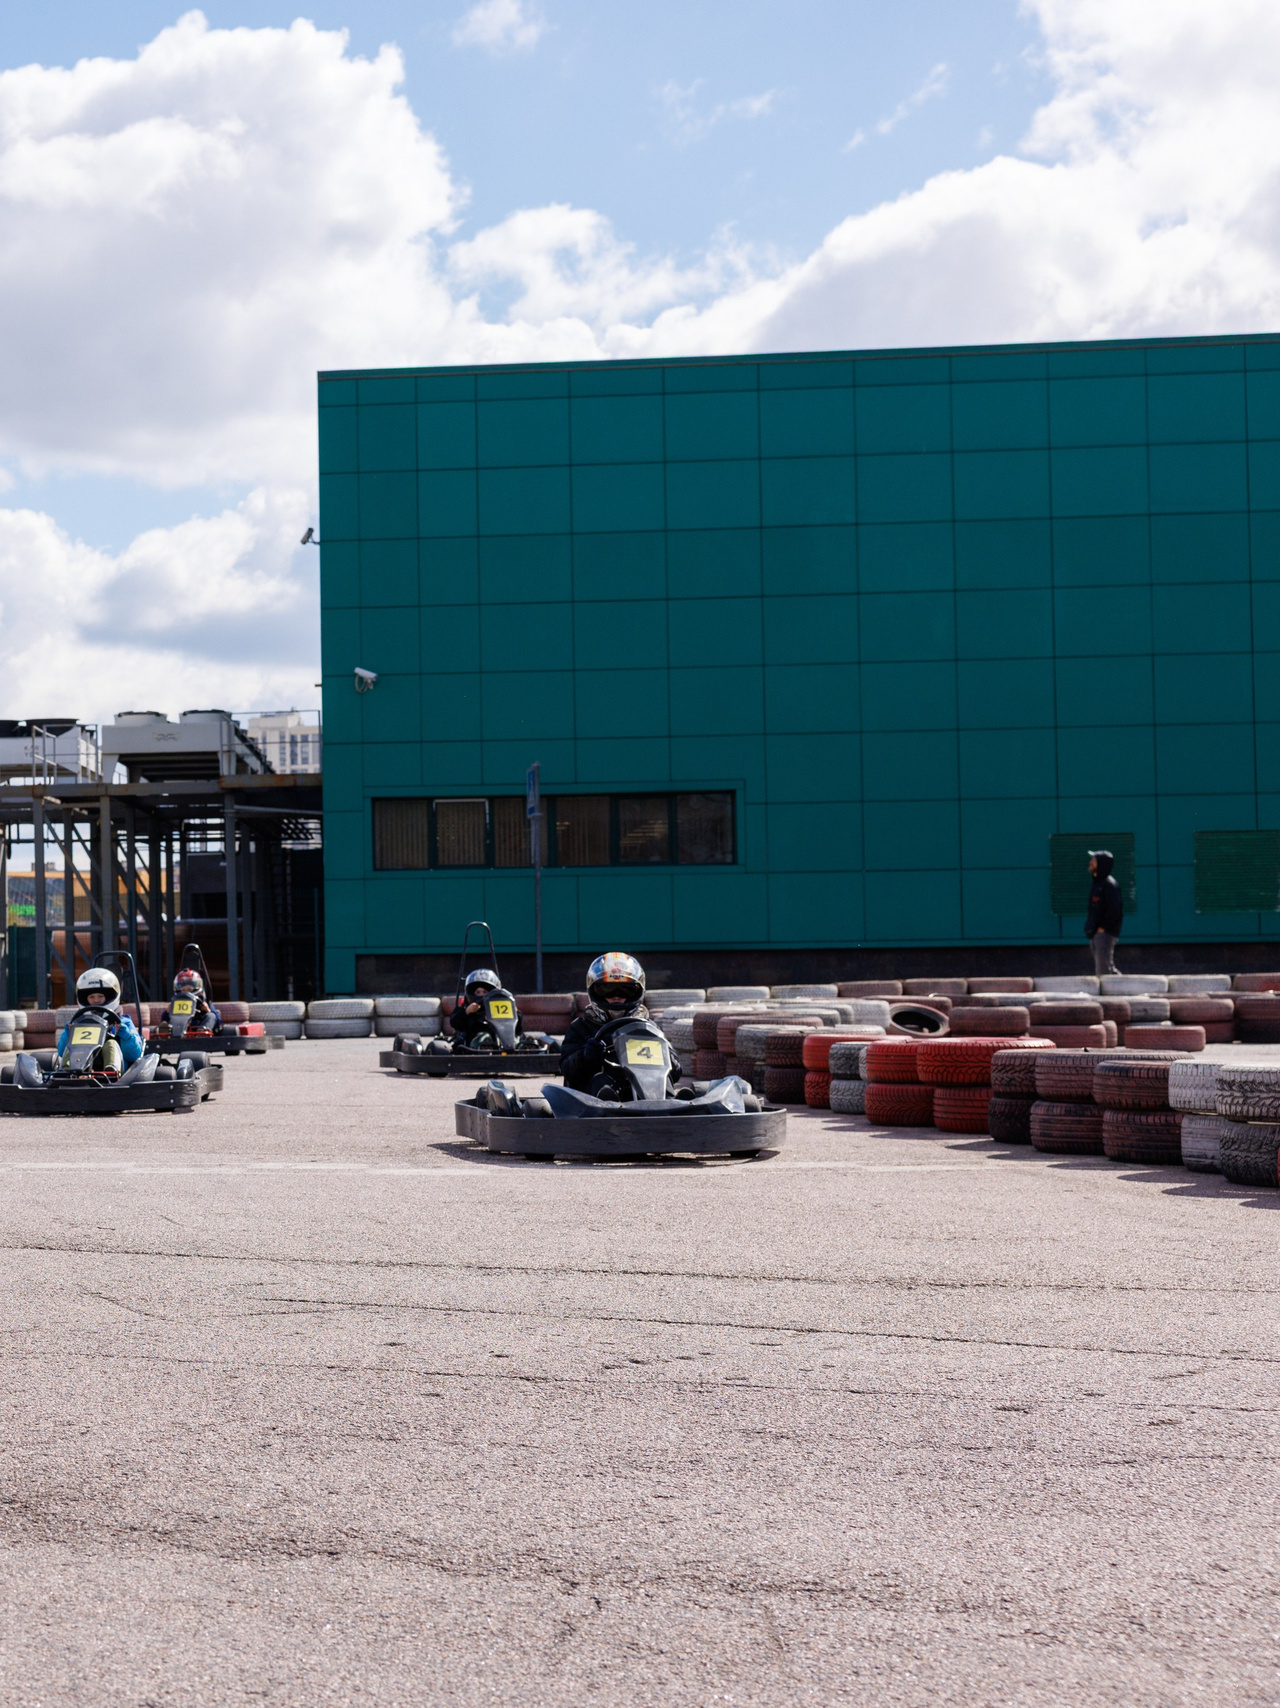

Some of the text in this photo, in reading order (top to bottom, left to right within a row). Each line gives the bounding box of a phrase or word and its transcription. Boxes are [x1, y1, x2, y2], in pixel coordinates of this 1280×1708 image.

[178, 1003, 188, 1011] 10
[495, 1005, 509, 1014] 12
[80, 1031, 92, 1040] 2
[637, 1047, 653, 1058] 4
